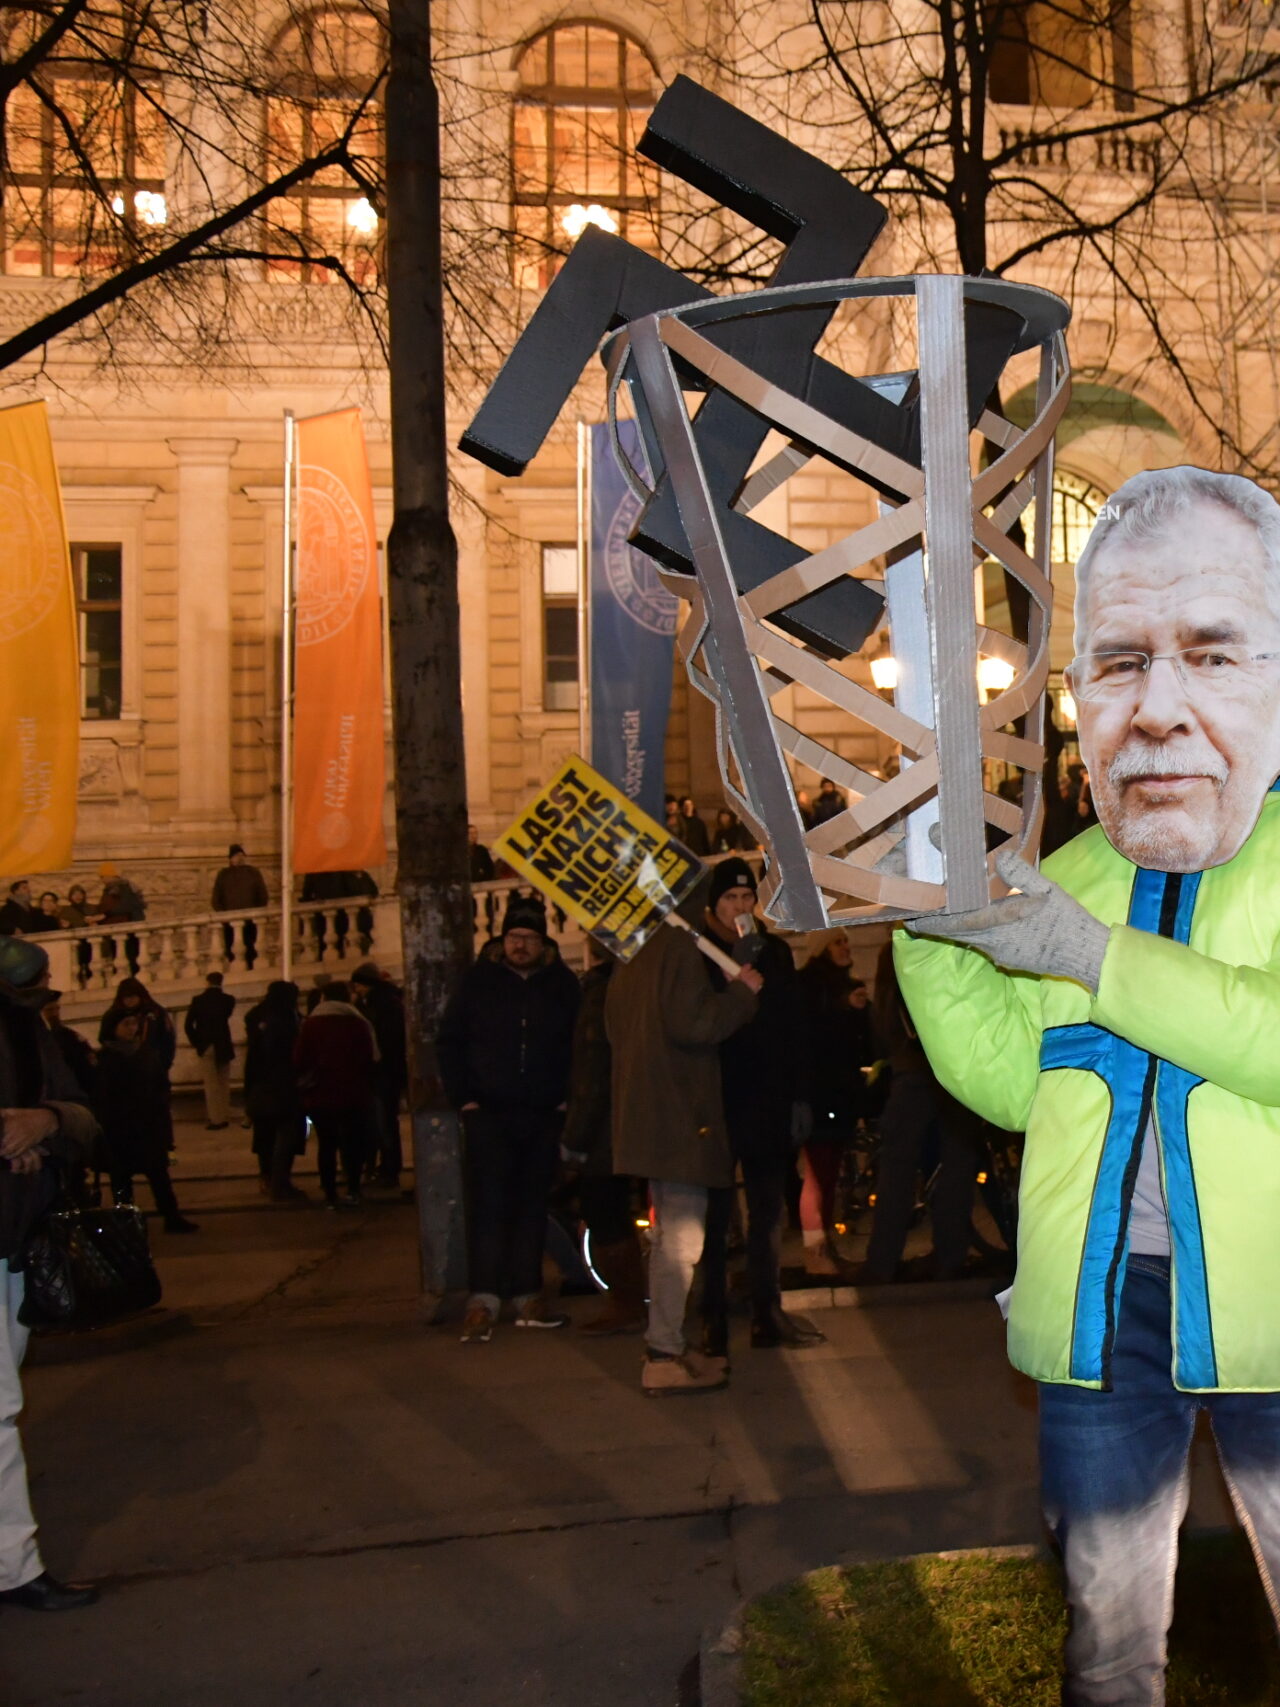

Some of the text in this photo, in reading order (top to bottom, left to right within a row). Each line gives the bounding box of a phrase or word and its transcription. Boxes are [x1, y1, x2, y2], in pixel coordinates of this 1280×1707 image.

[506, 768, 589, 860] LASST
[531, 792, 617, 882] NAZIS
[556, 811, 639, 903] NICHT
